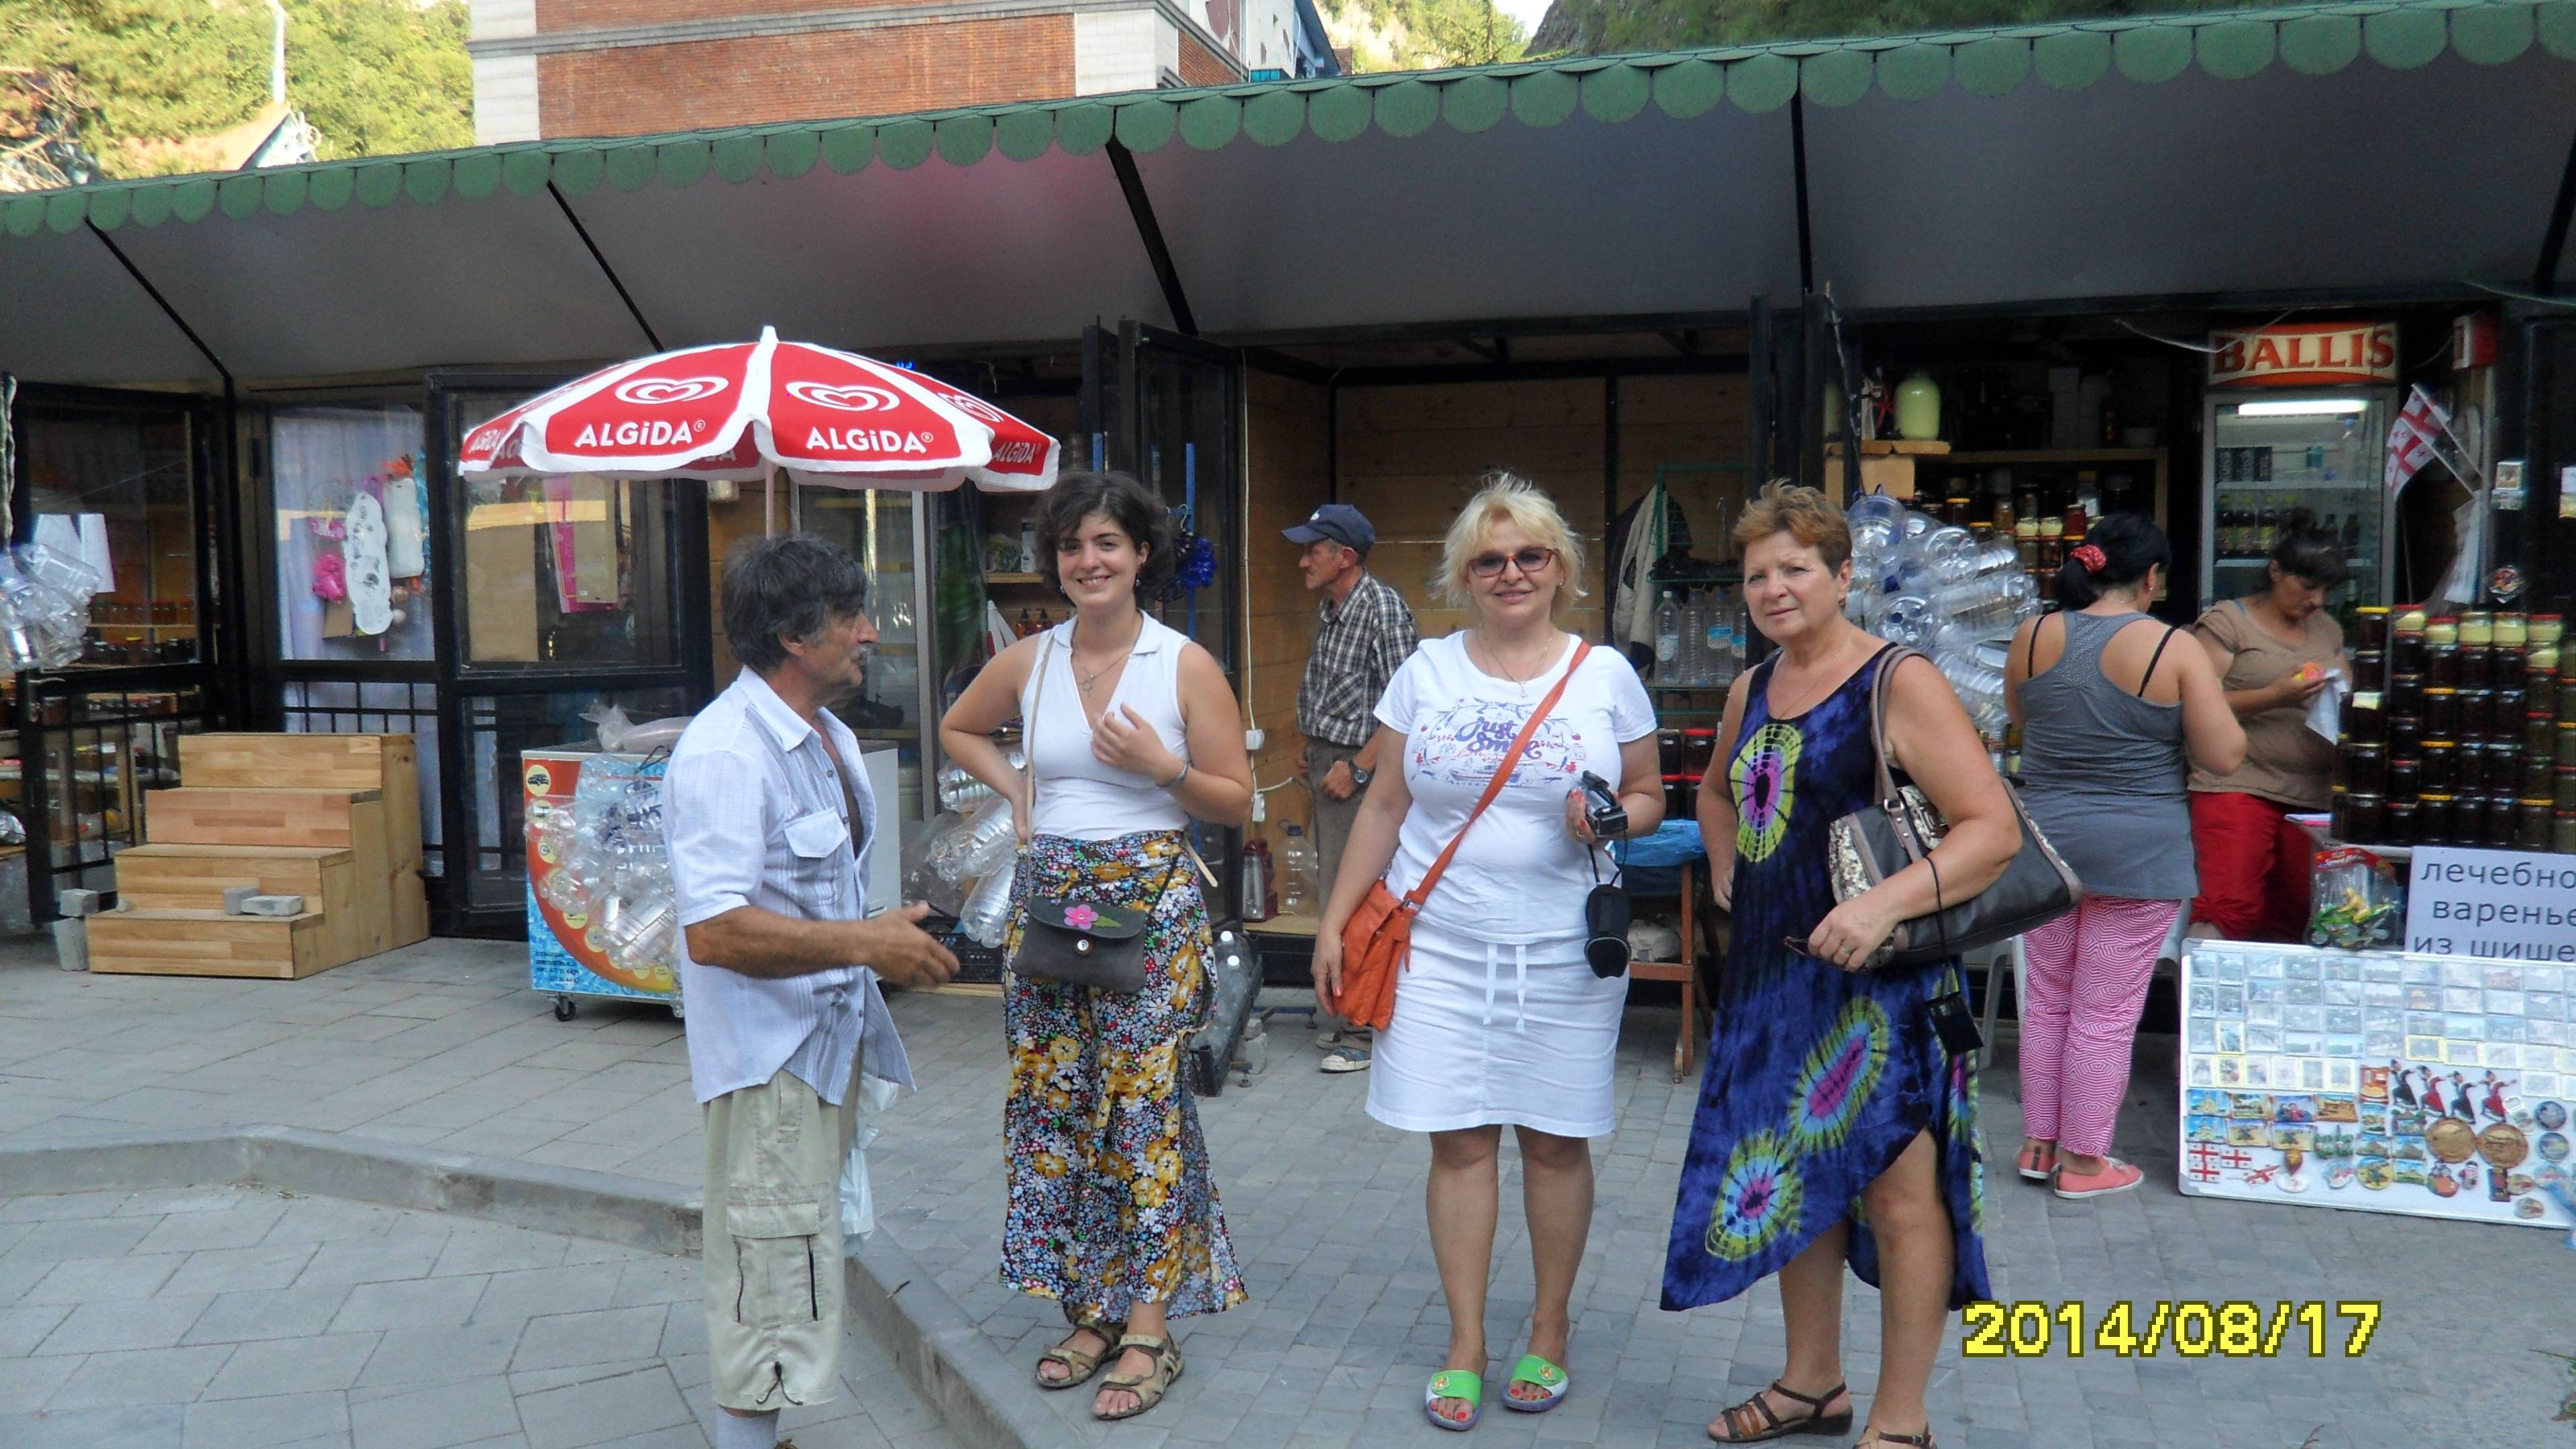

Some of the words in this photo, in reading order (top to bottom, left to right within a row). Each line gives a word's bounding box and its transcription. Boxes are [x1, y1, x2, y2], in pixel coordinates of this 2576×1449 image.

[2213, 330, 2394, 374] BALLIS
[1454, 716, 1518, 741] Just
[1466, 732, 1542, 759] Sme
[2420, 862, 2576, 890] лечебно
[2414, 936, 2453, 955] из
[2470, 940, 2575, 962] шише
